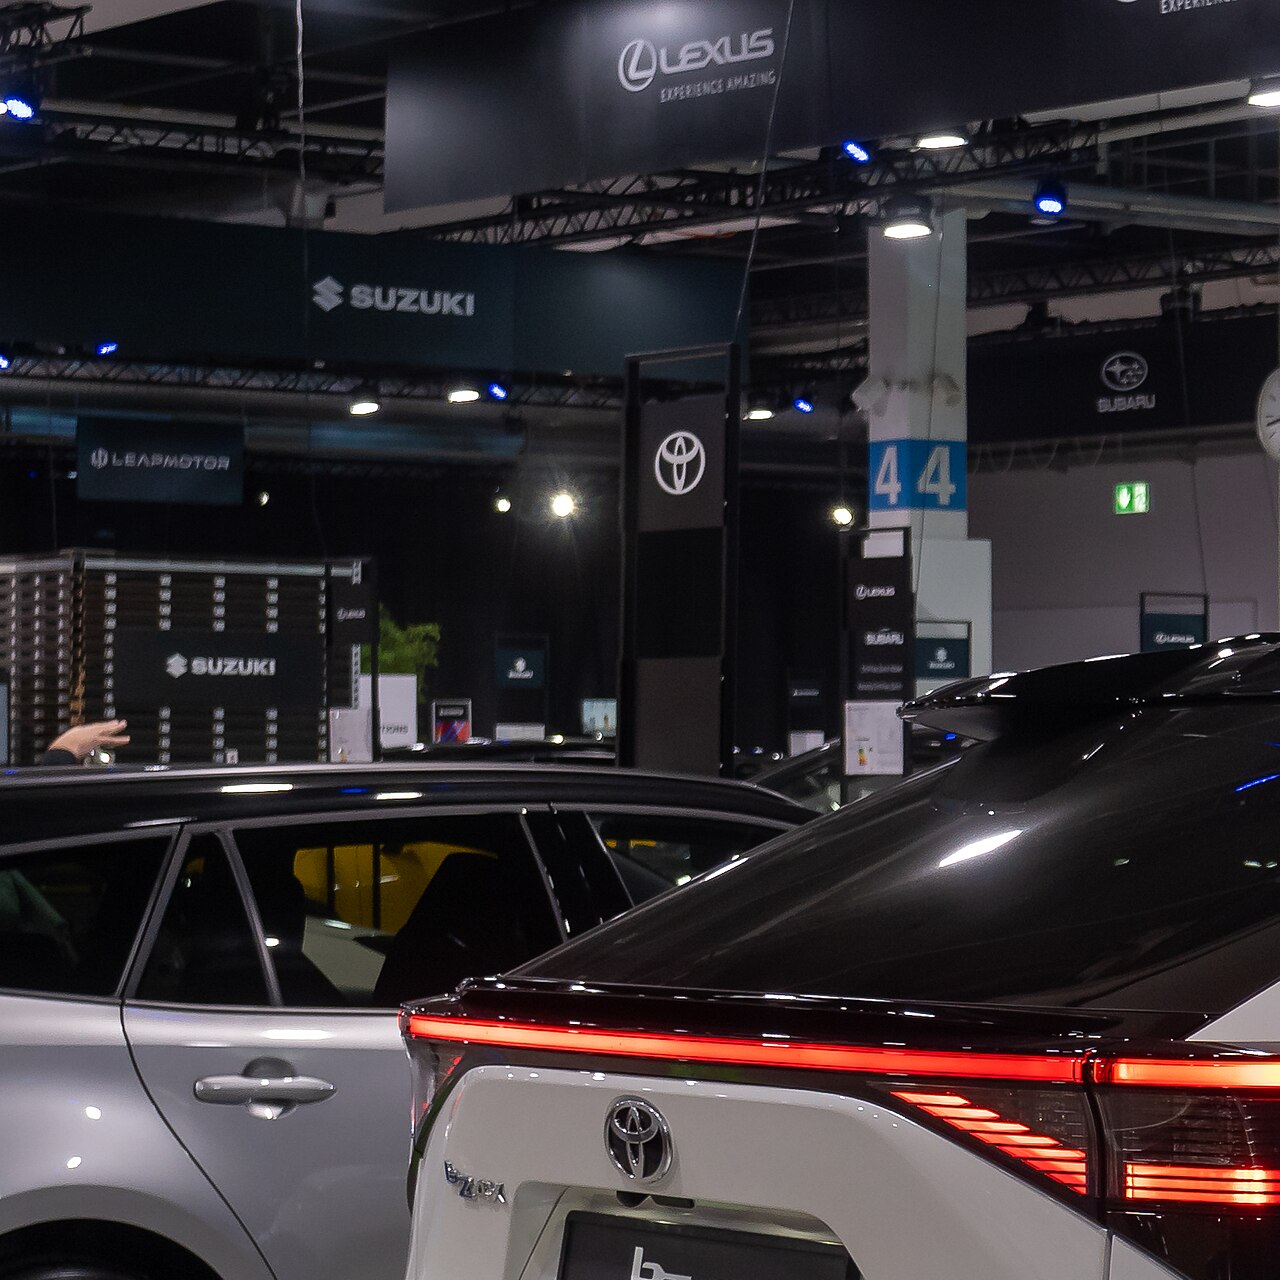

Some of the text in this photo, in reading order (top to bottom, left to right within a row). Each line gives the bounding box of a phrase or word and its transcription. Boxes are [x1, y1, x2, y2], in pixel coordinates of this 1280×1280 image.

[659, 28, 775, 74] LEXUS
[659, 69, 777, 104] EXPERIENCE AMAZING
[350, 283, 476, 317] SUZUKI
[1096, 393, 1156, 414] SUBARU
[111, 451, 231, 472] LEAPMOTOR
[874, 445, 902, 505] 4
[917, 445, 957, 506] 4
[190, 656, 277, 677] SUZUKI
